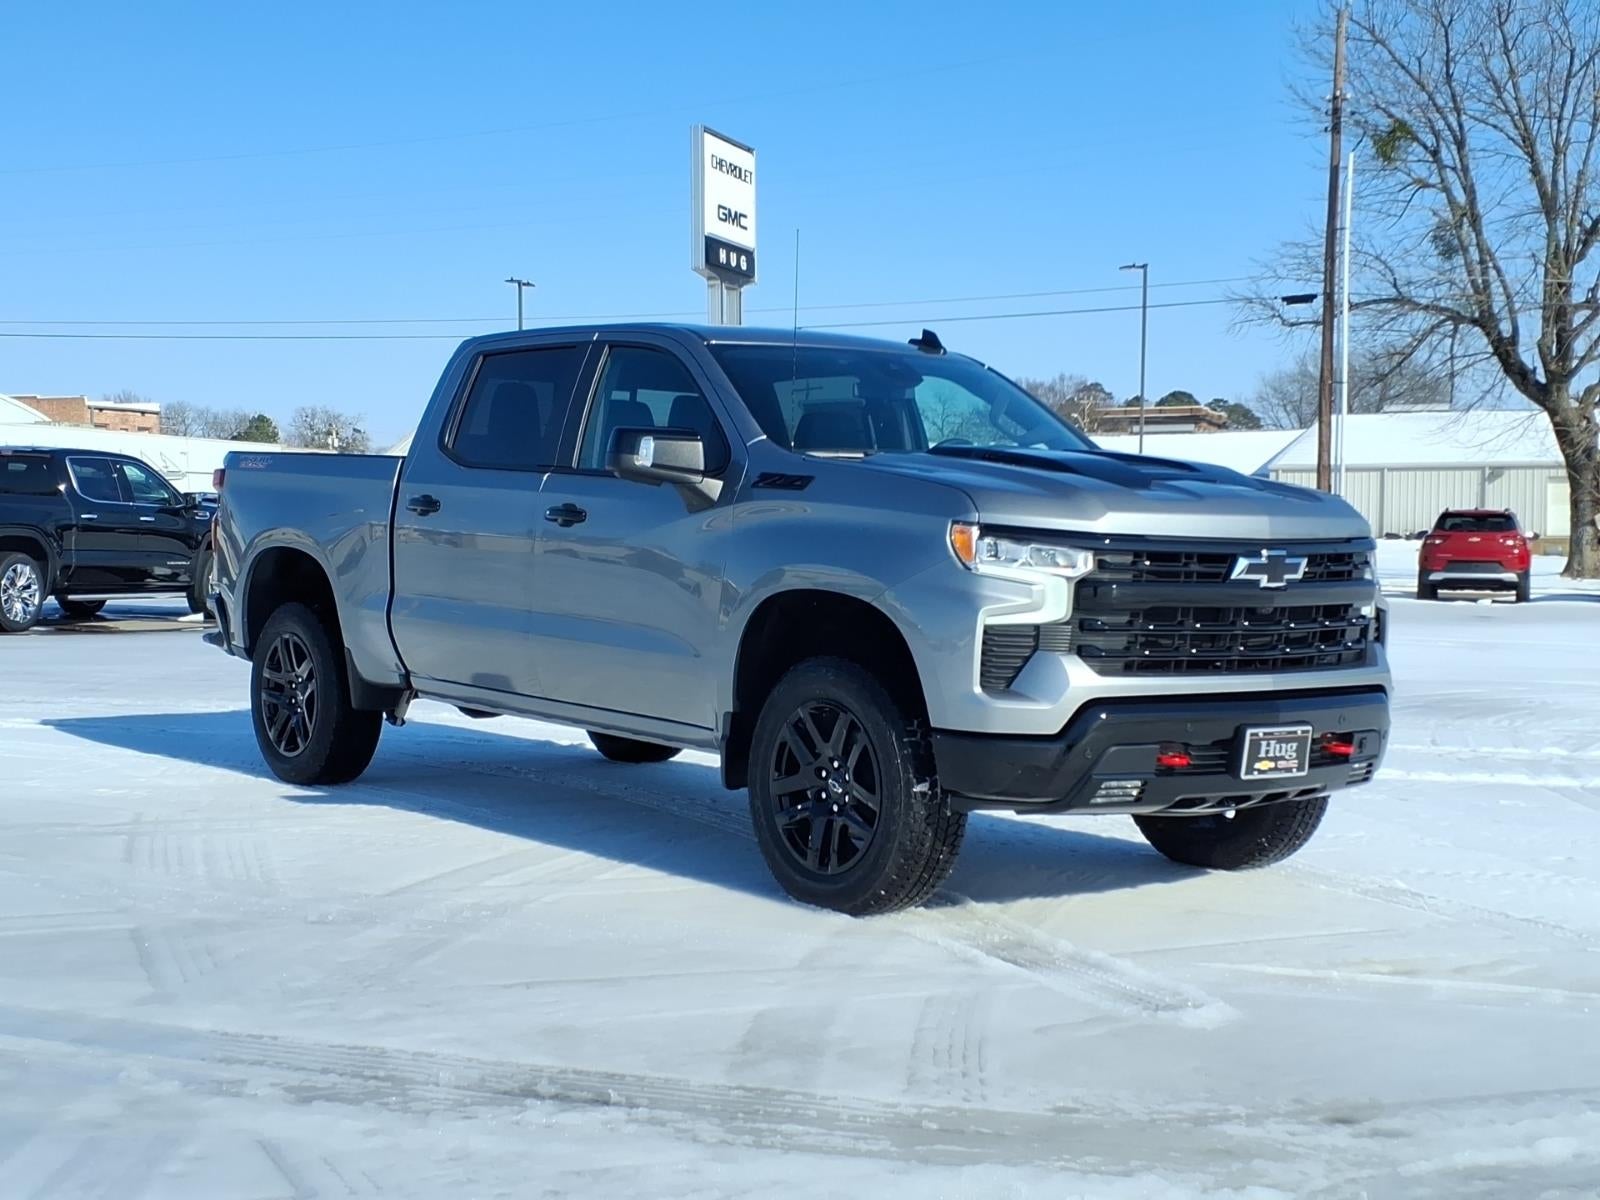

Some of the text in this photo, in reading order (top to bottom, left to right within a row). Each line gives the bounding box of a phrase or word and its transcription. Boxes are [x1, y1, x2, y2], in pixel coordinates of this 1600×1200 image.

[711, 154, 753, 185] CHEVROLET
[717, 204, 748, 231] GMC
[719, 248, 747, 271] HUG
[1258, 740, 1298, 760] Hug
